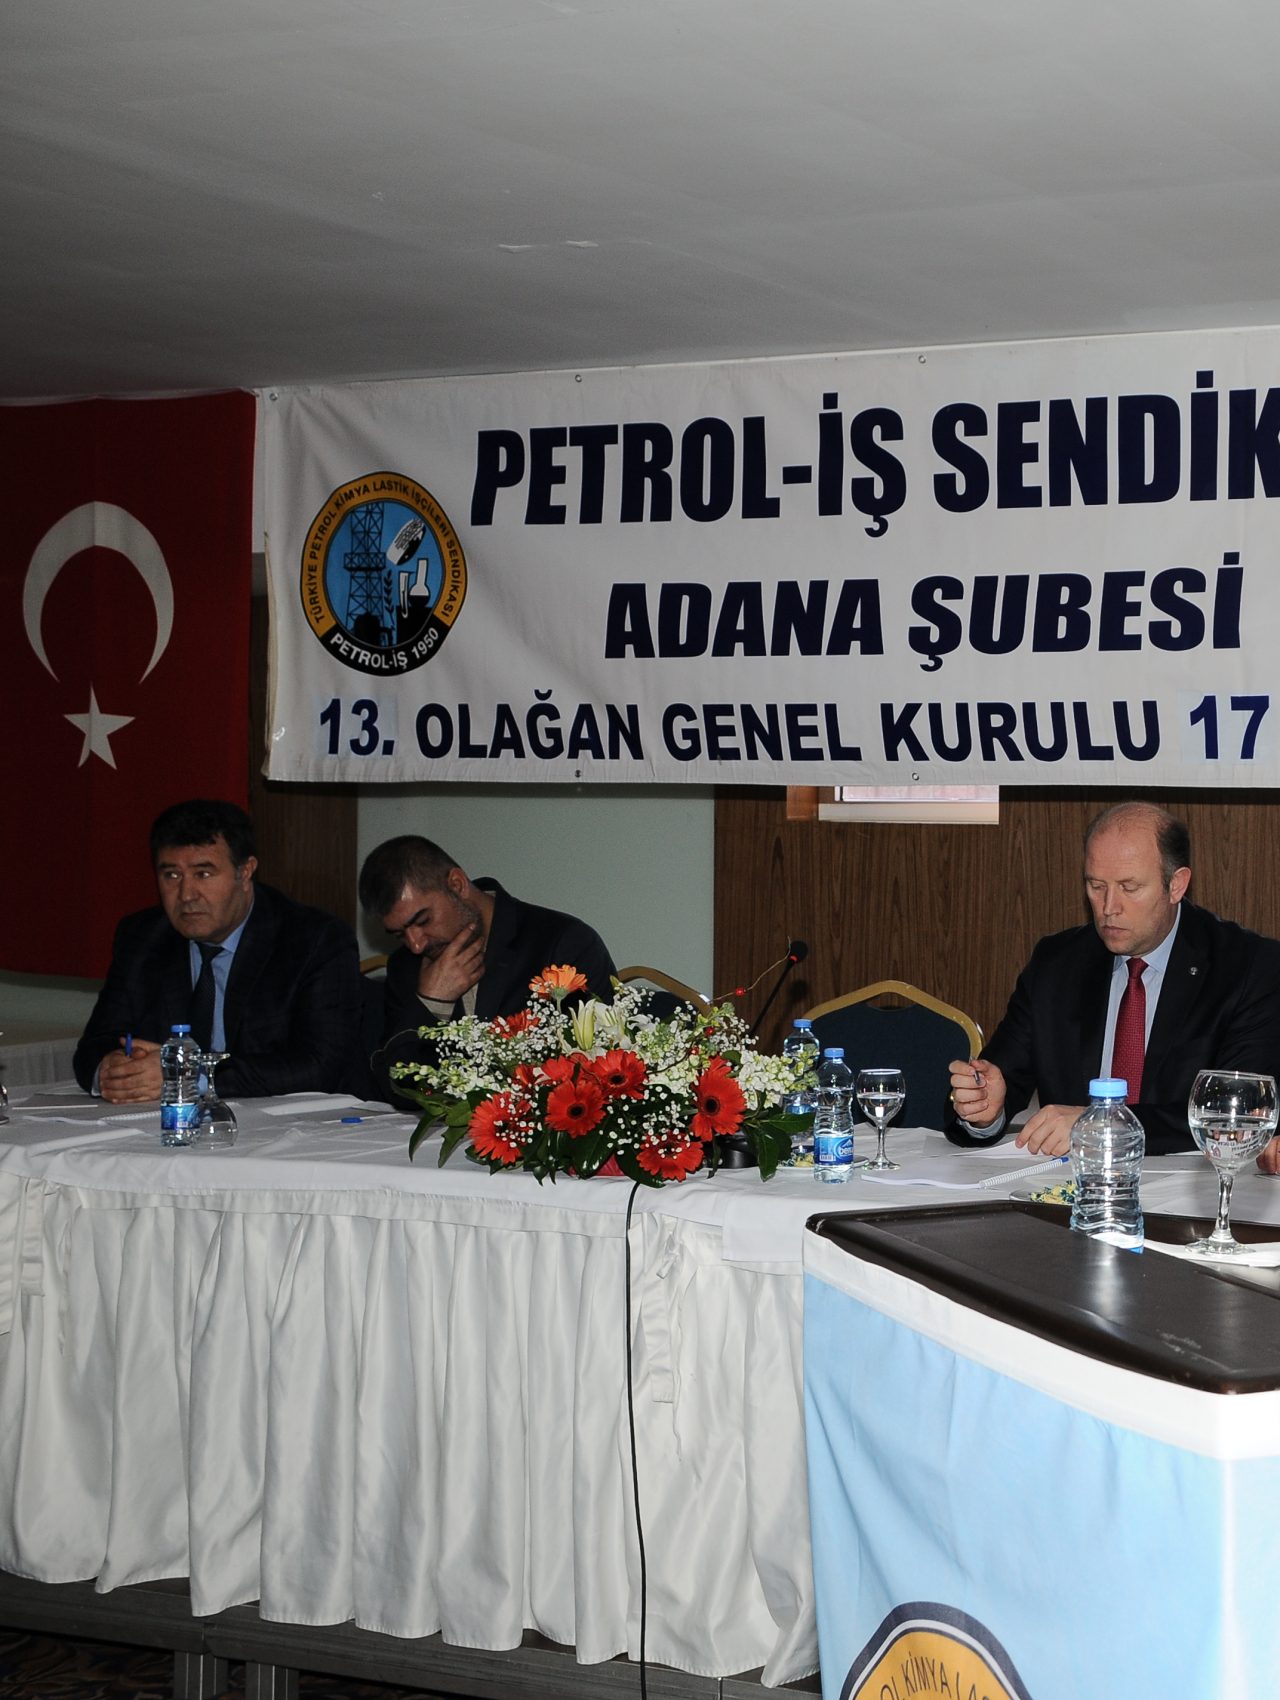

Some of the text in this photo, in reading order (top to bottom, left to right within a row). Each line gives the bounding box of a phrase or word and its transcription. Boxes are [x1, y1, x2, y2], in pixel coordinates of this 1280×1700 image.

[471, 393, 906, 537] PETROL-İŞ
[309, 479, 460, 624] TÜRKİYE PETROL KİMYA LASTİK İŞÇİLERİ SENDİKASI
[330, 627, 439, 669] PETROL-İŞ 1950
[605, 552, 1243, 671] ADANA ŞUBESİ
[320, 699, 394, 755] 13.
[416, 690, 644, 760] OLAĞAN
[663, 704, 862, 761] GENEL
[881, 701, 1159, 761] KURULU
[1190, 696, 1269, 759] 17
[901, 1651, 951, 1698] KİMYA
